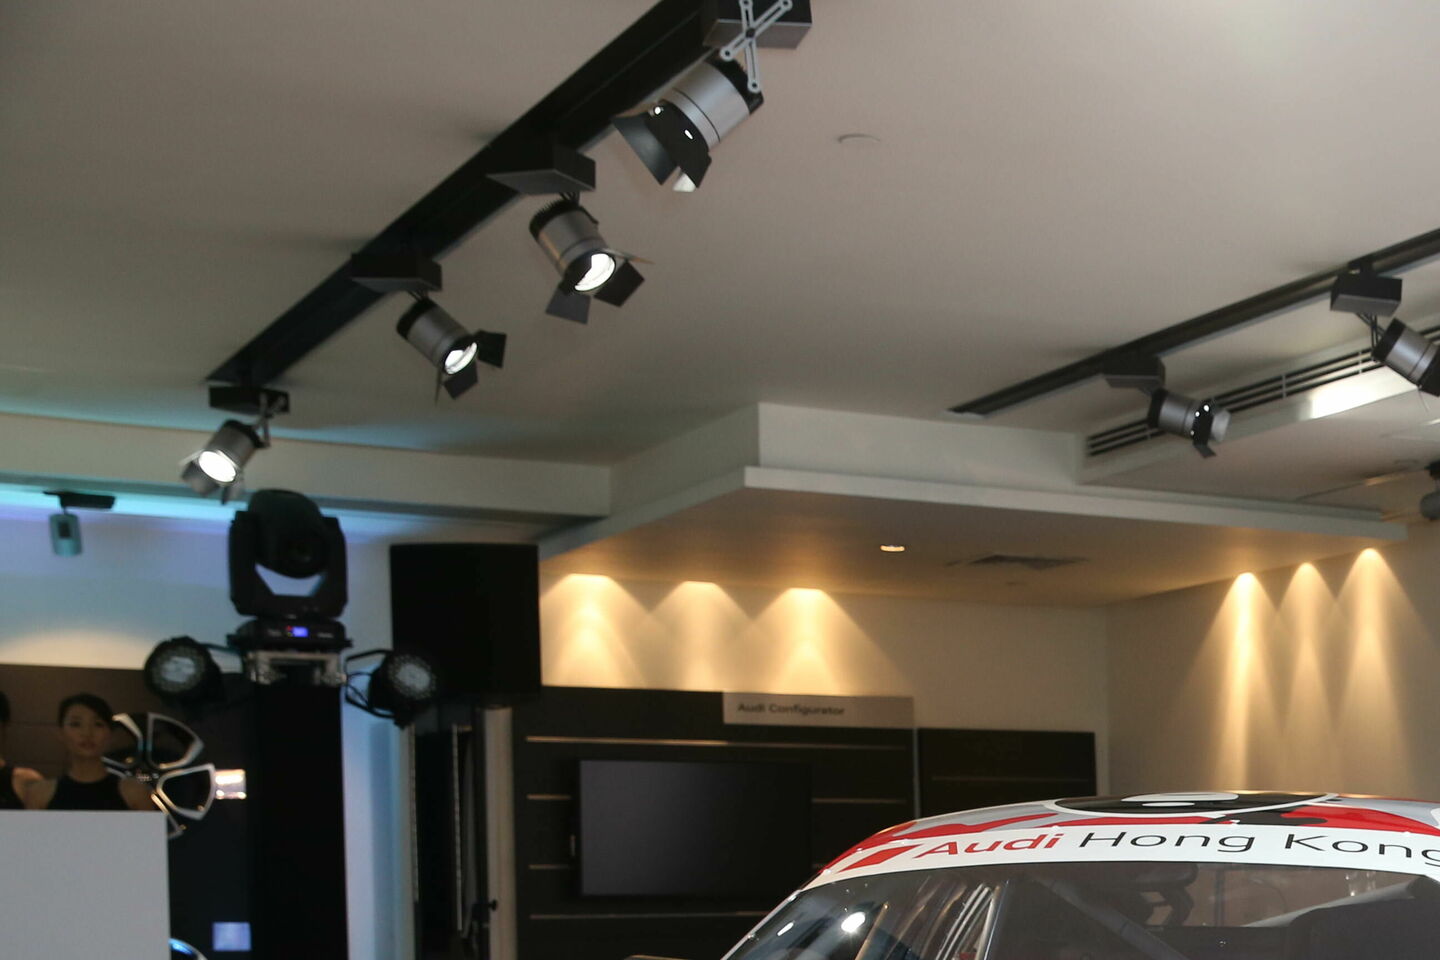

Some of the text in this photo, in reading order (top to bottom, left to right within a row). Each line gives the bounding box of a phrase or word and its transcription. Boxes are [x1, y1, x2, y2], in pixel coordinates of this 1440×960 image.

[737, 703, 845, 716] Audi Configurator
[914, 833, 1063, 858] Audi
[1079, 831, 1255, 854] Hong
